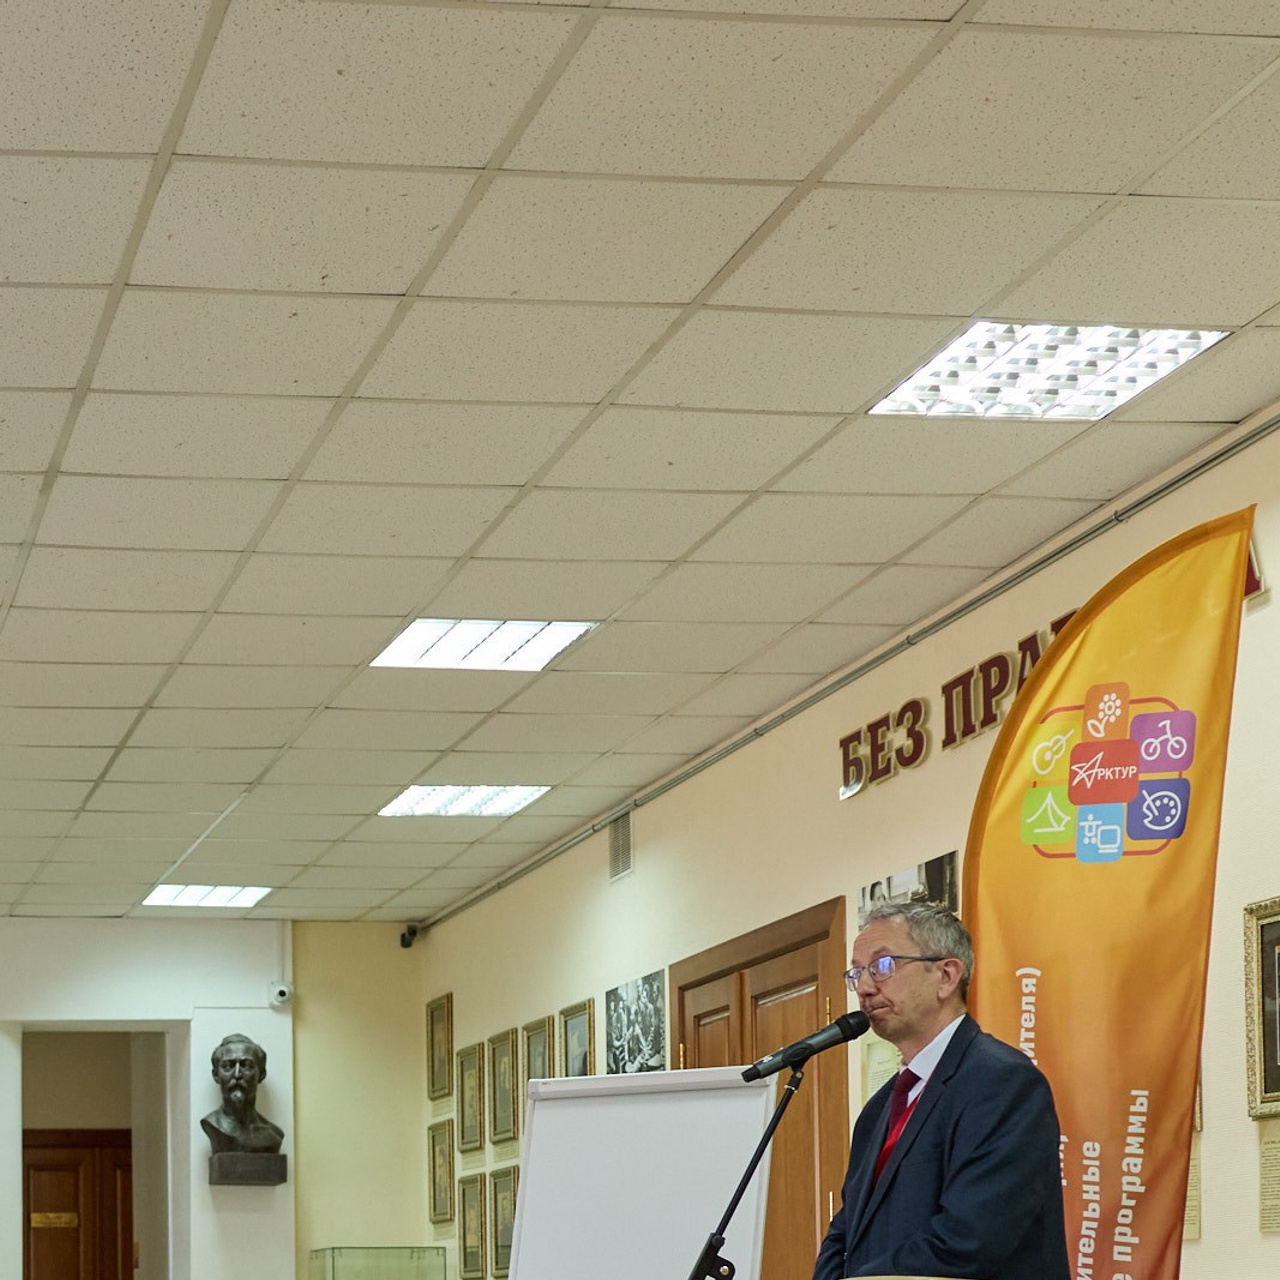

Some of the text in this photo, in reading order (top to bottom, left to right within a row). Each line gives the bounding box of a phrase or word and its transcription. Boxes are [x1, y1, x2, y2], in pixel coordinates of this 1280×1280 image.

[839, 608, 1080, 801] БЕЗ ПРА
[1071, 751, 1137, 789] АРКТУР
[1016, 967, 1042, 1066] ителя)
[1112, 1089, 1149, 1262] программы
